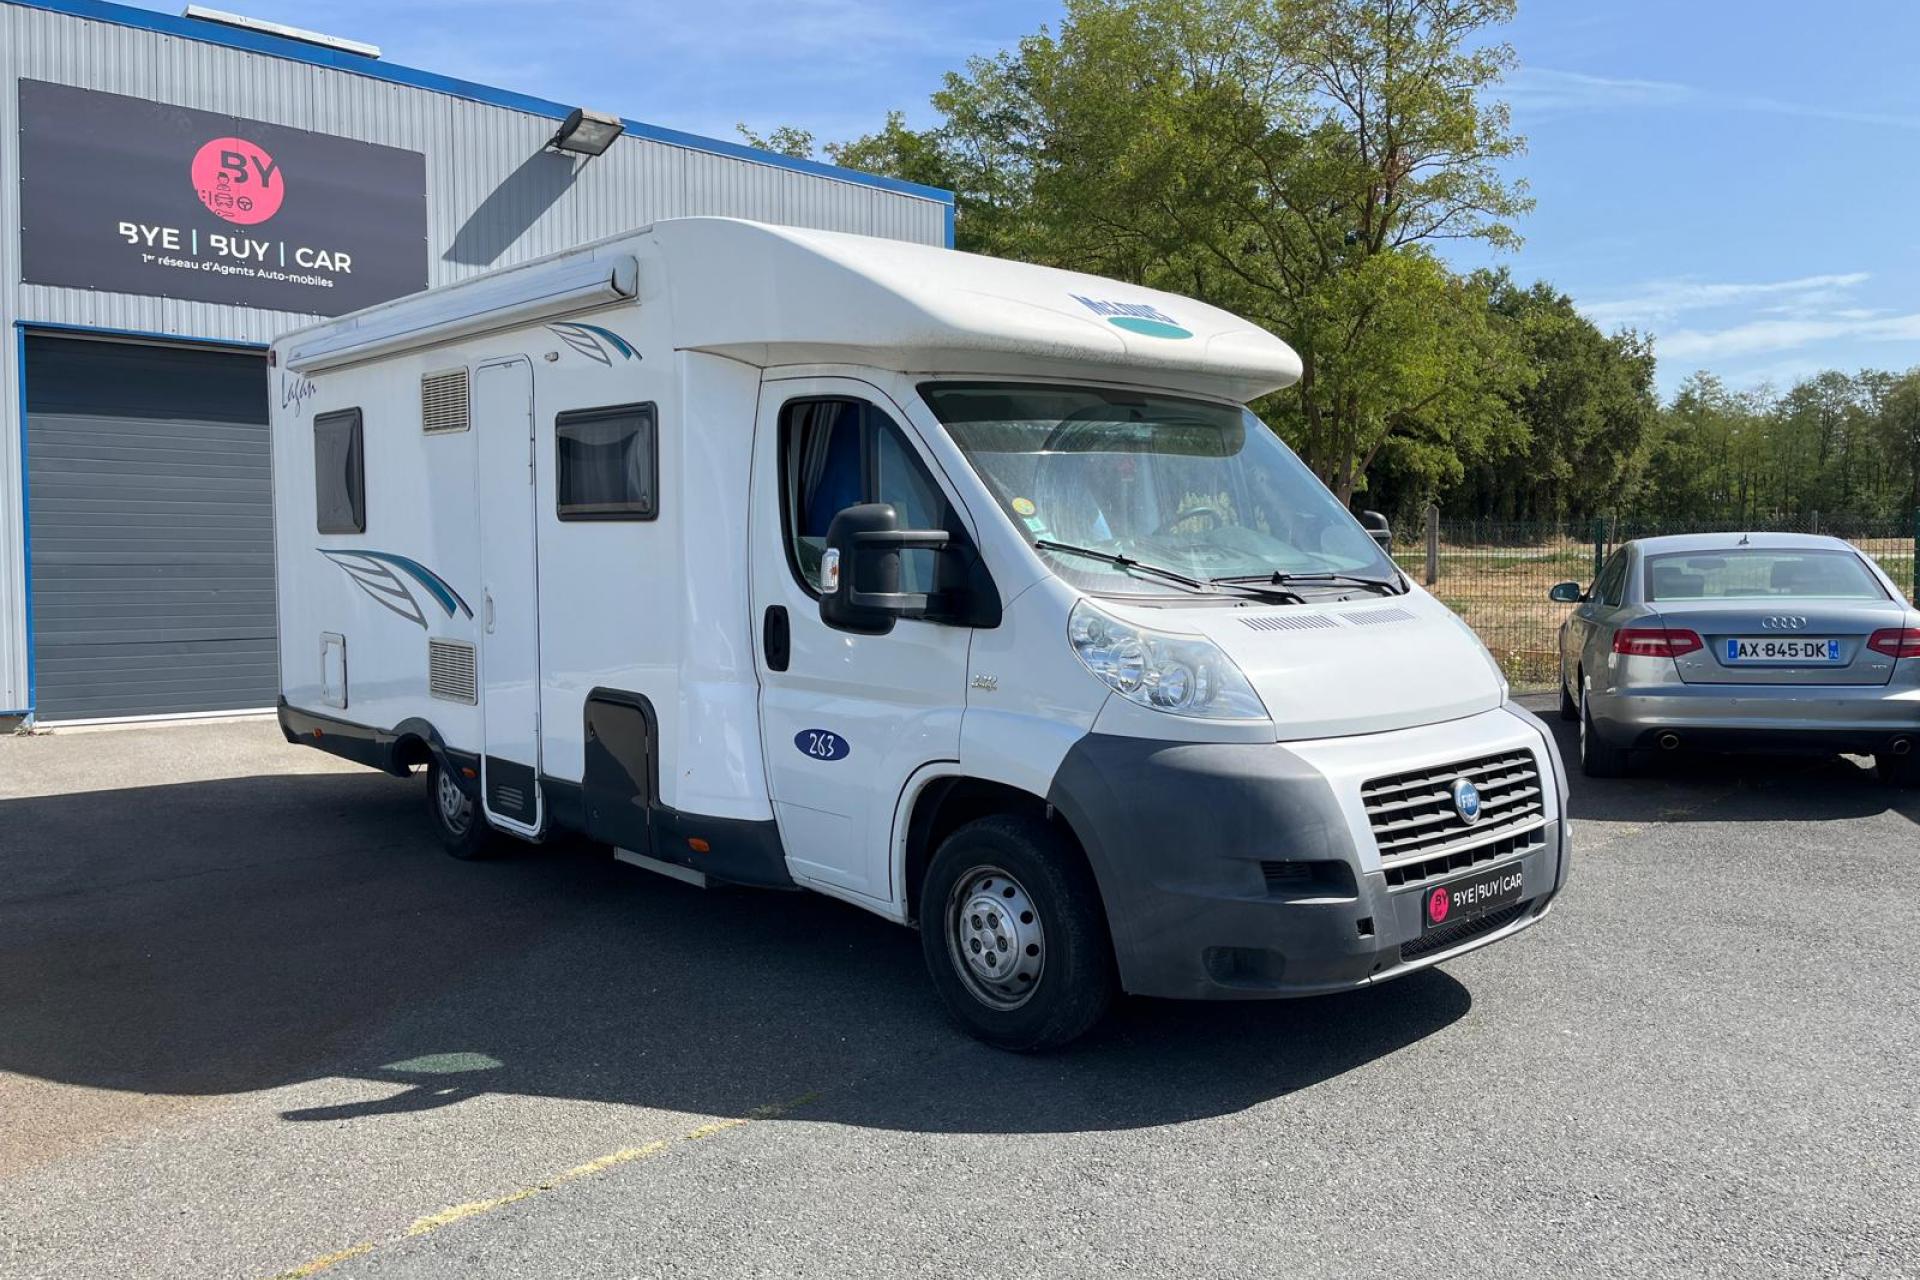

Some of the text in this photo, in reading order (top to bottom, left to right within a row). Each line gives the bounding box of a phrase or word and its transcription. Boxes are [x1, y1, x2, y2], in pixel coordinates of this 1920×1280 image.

[220, 150, 278, 188] BY
[119, 221, 352, 273] BYE BUY CAR
[157, 256, 199, 270] réseau
[202, 260, 255, 276] d'Agents
[257, 268, 334, 288] Auto-mobiles
[809, 732, 836, 758] 263
[1503, 873, 1523, 891] CAR
